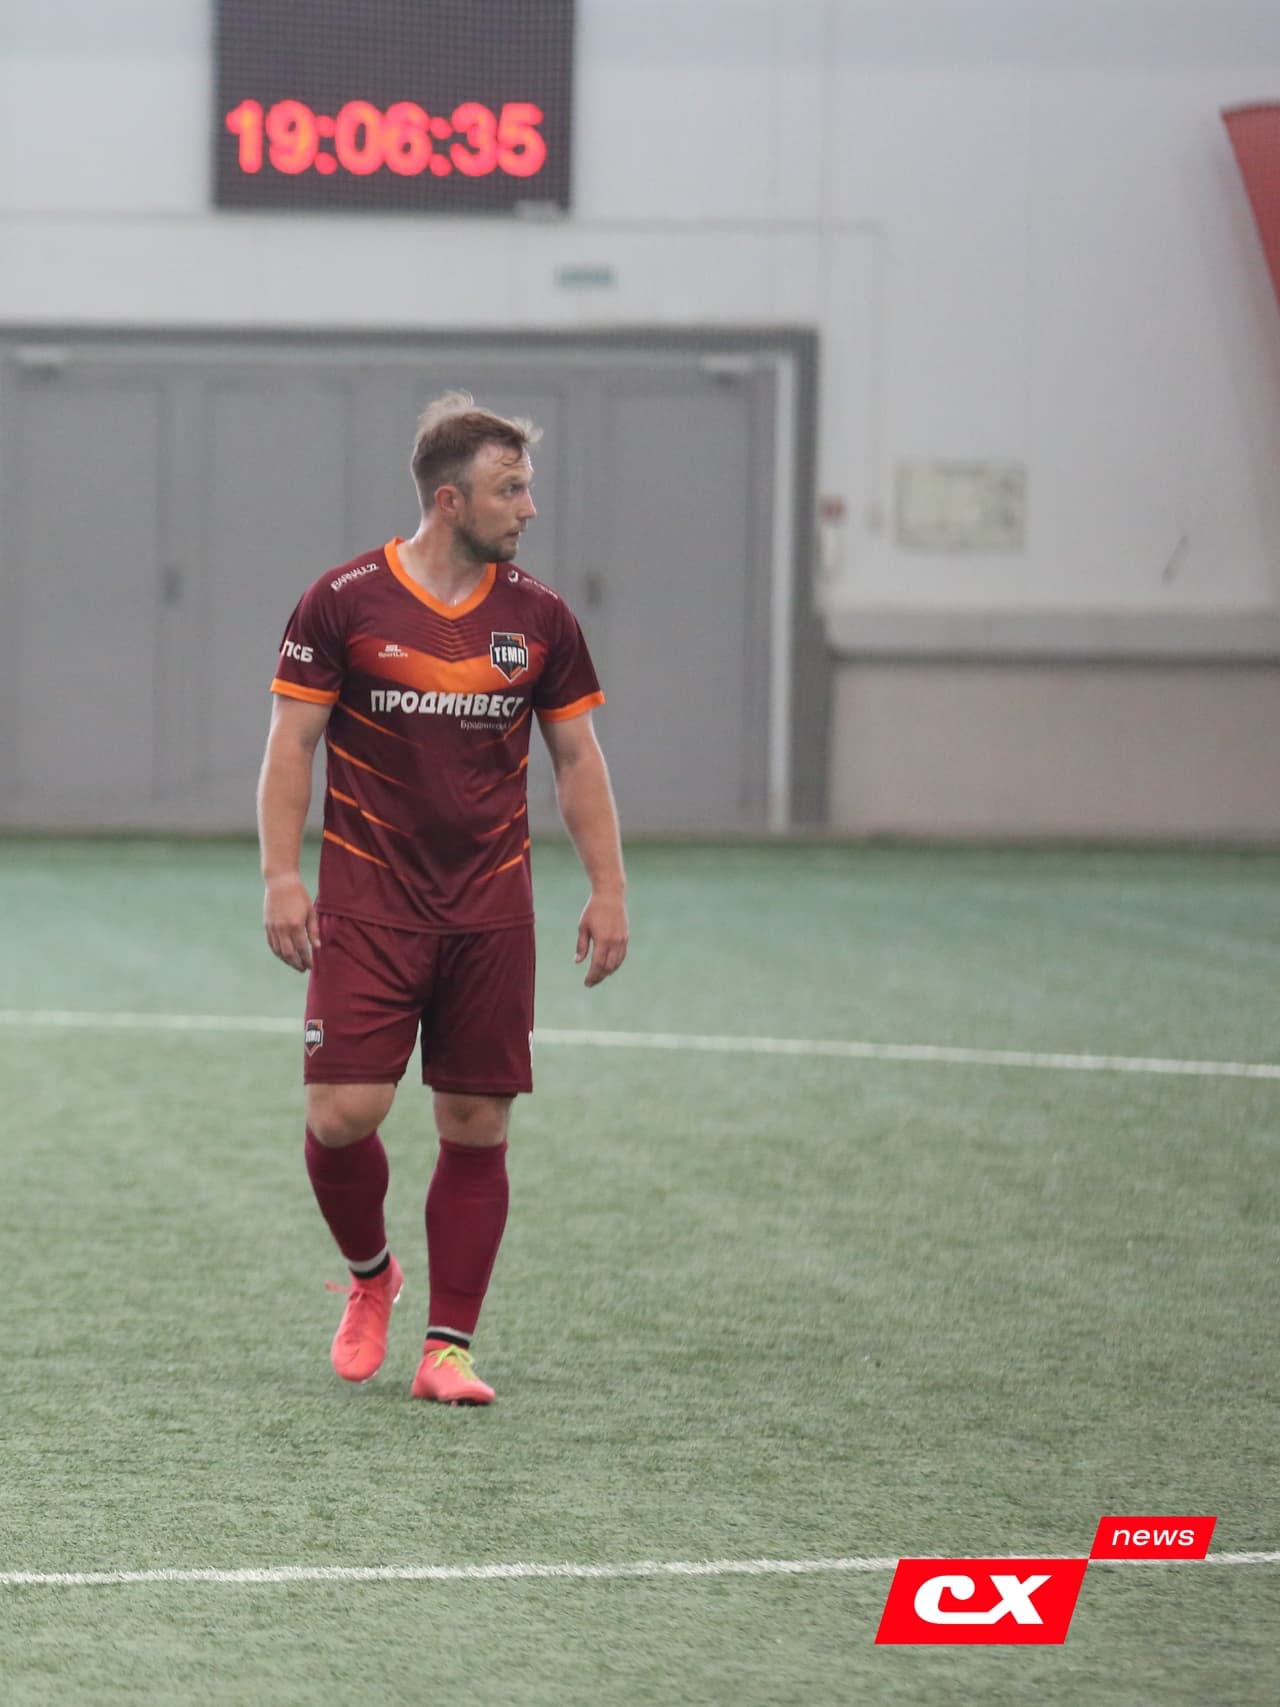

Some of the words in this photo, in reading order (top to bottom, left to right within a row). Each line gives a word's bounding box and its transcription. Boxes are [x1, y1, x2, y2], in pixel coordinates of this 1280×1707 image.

[225, 98, 548, 178] 19:06:35
[494, 646, 526, 666] ТЕМП
[370, 689, 525, 718] ПРОДИНВЕСТ
